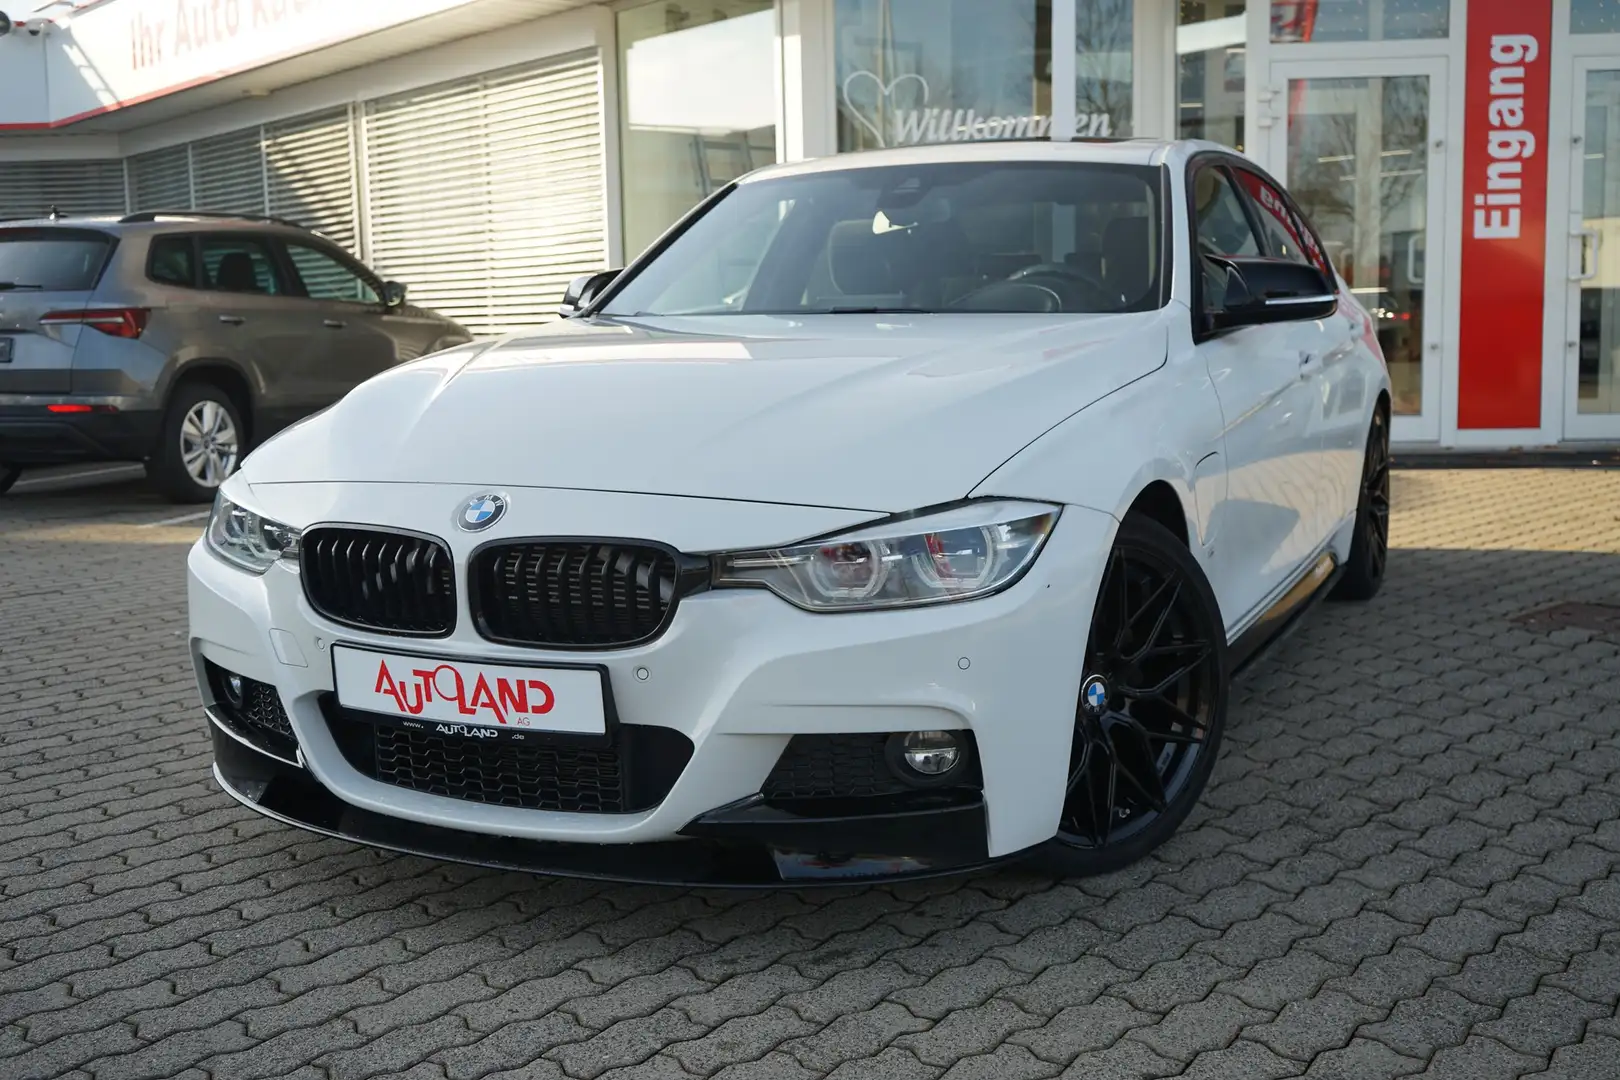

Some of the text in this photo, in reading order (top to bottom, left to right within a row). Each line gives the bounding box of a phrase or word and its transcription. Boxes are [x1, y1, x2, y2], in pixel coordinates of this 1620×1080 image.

[130, 11, 165, 70] Ihr
[174, 0, 240, 57] Auto
[1473, 34, 1539, 240] Eingang
[517, 717, 531, 727] AG
